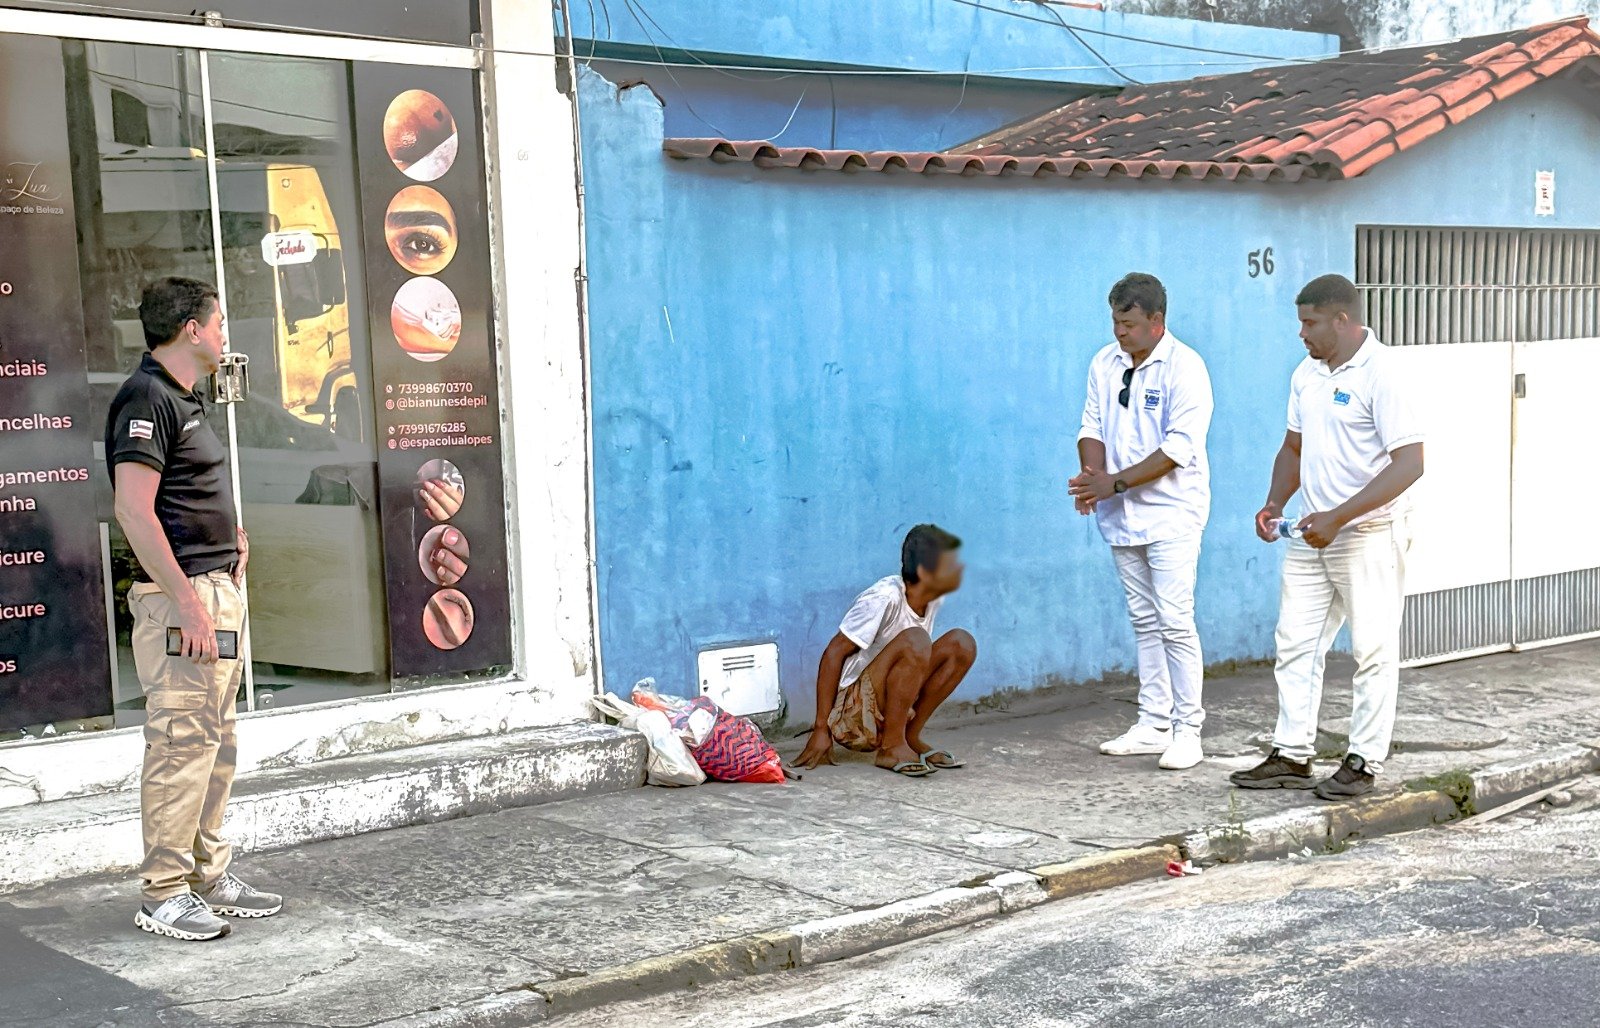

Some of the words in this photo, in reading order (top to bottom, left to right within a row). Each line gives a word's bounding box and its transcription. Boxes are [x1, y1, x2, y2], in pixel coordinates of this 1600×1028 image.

[36, 206, 64, 214] Beleza
[1248, 246, 1274, 278] 56
[398, 382, 473, 394] 73998670370
[396, 395, 487, 410] @bianunesdepil
[0, 413, 72, 431] ncelhas
[398, 422, 467, 435] 73991676285
[399, 435, 493, 450] @espacolualopes
[0, 495, 36, 512] nha
